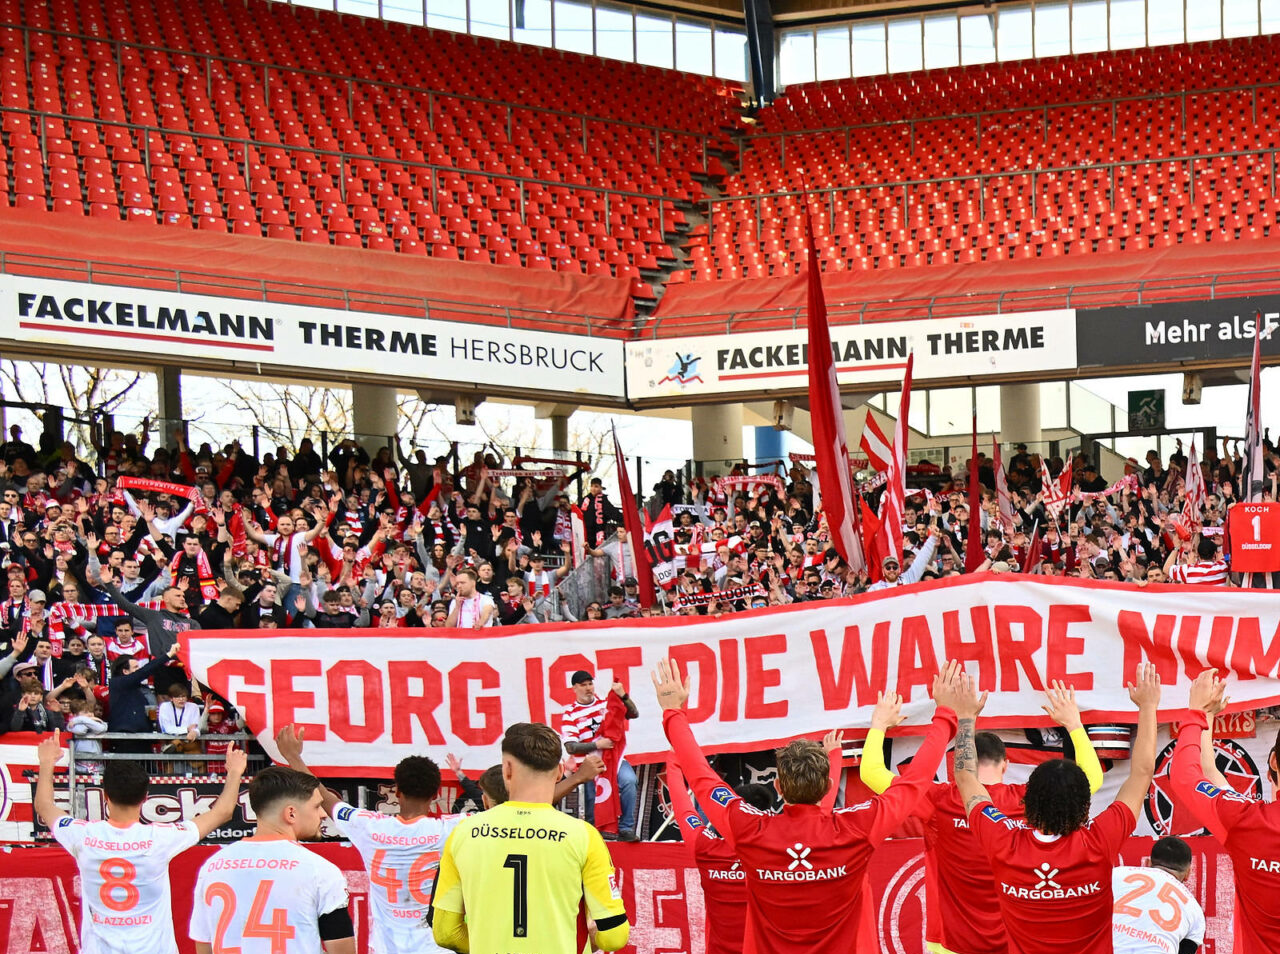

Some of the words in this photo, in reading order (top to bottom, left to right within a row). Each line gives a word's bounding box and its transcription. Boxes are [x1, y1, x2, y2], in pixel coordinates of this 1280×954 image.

[18, 293, 274, 341] FACKELMANN
[299, 321, 438, 357] THERME
[450, 329, 605, 374] HERSBRUCK
[927, 326, 1044, 356] THERME
[1145, 317, 1212, 345] Mehr
[1218, 315, 1257, 341] als
[1251, 515, 1261, 541] 1
[1241, 542, 1272, 550] DÜSSELDORF
[207, 658, 503, 746] GEORG
[670, 634, 789, 724] DIE
[810, 604, 1094, 711] WAHRE
[84, 837, 153, 851] DÜSSELDORF
[371, 832, 441, 846] DÜSSELDORF
[471, 824, 568, 842] DÜSSELDORF
[207, 857, 299, 873] DÜSSELDORF
[708, 869, 746, 880] TARGO
[756, 865, 847, 882] TARGOBANK
[98, 857, 140, 912] 8
[370, 848, 441, 905] 46
[503, 854, 528, 938] 1
[1001, 881, 1101, 900] TARGOBANK
[392, 908, 422, 919] SUSO
[1113, 873, 1189, 933] 25
